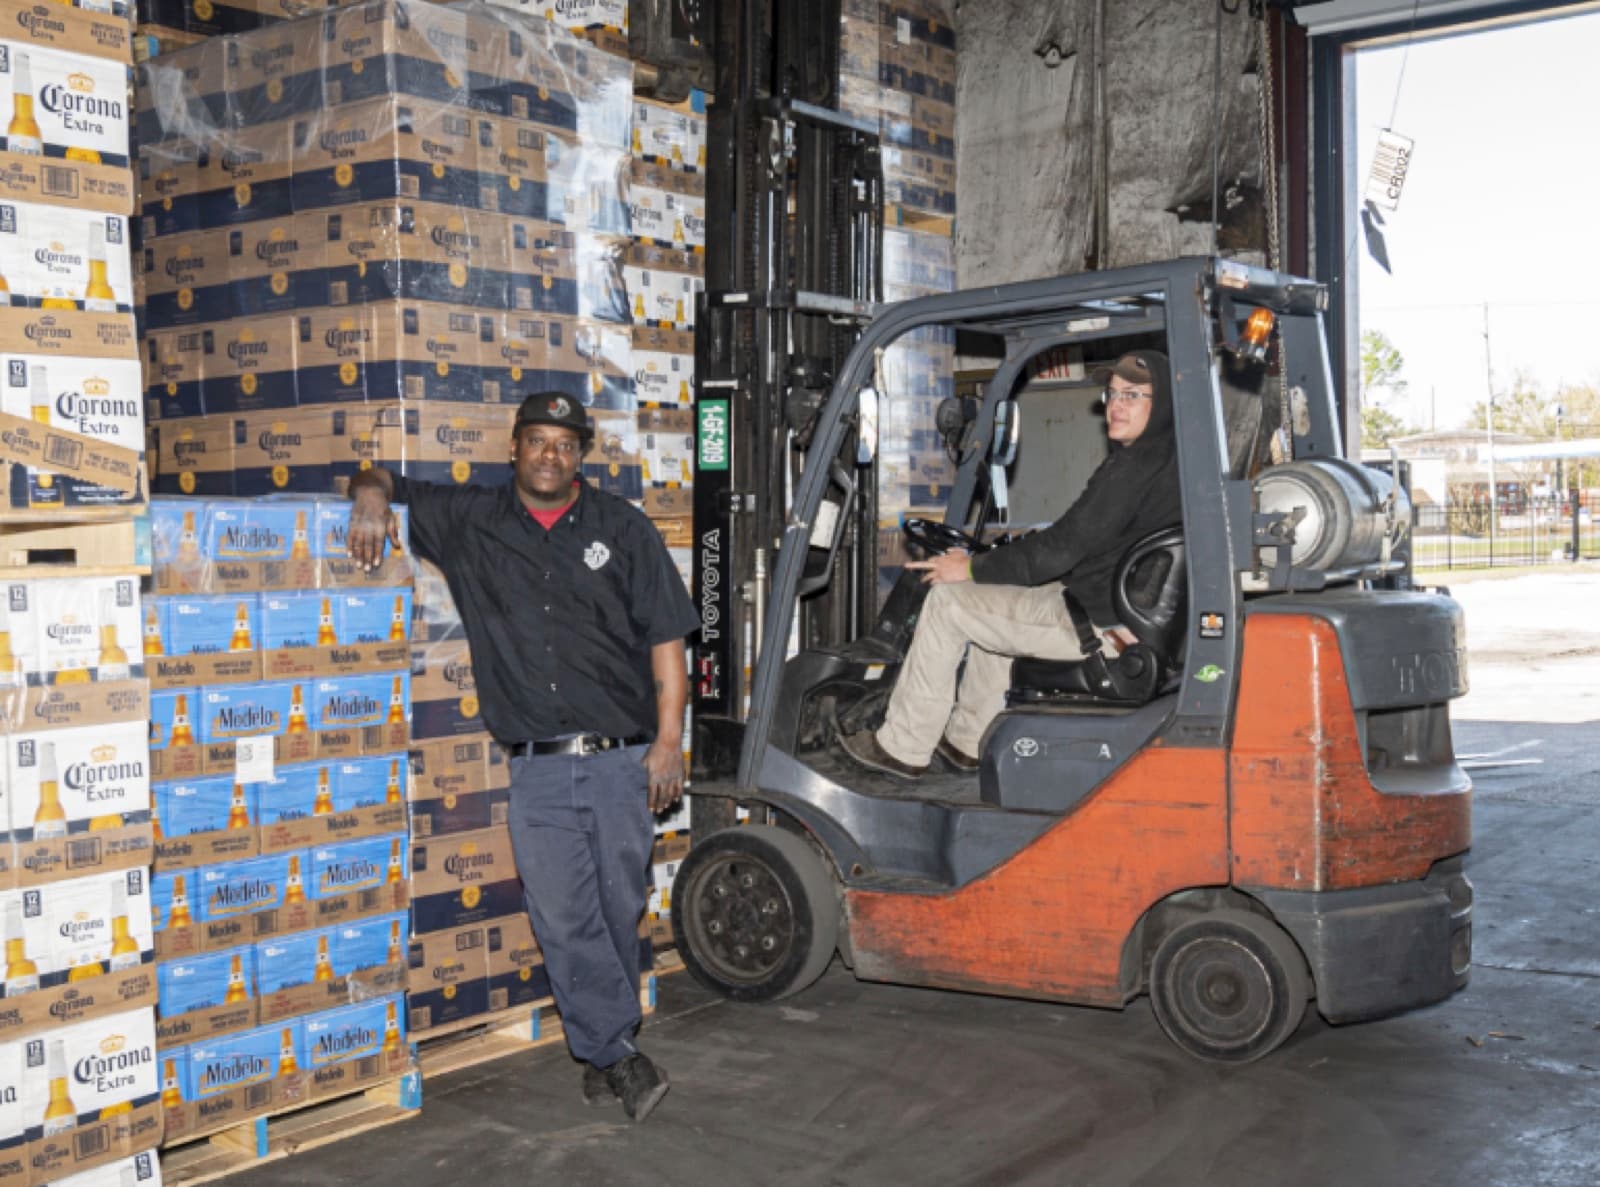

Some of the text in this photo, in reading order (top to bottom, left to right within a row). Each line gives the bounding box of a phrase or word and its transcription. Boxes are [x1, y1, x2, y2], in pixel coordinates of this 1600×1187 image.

[16, 10, 65, 33] Corona
[40, 83, 122, 120] Corona
[63, 112, 104, 135] Extra
[320, 127, 367, 149] Corona
[1386, 148, 1411, 200] CR002
[34, 248, 82, 265] Corona
[256, 238, 299, 260] Corona
[25, 323, 72, 338] Corona
[324, 327, 371, 349] Corona
[226, 340, 269, 360] Corona
[56, 391, 138, 420] Corona
[79, 416, 119, 434] Extra
[436, 424, 483, 445] Corona
[702, 405, 725, 464] 1-GF-209
[258, 430, 302, 451] Corona
[226, 525, 280, 548] Modelo
[702, 527, 721, 643] TOYOTA
[47, 623, 92, 638] Corona
[331, 650, 362, 663] Modelo
[157, 662, 195, 678] Modelo
[34, 701, 82, 717] Corona
[328, 694, 378, 716] Modelo
[219, 705, 274, 730] Modelo
[64, 760, 144, 791] Corona
[86, 784, 125, 802] Extra
[326, 860, 376, 885] Modelo
[444, 852, 494, 874] Corona
[216, 879, 270, 906] Modelo
[59, 918, 104, 938] Corona
[49, 996, 94, 1017] Corona
[319, 1026, 371, 1054] Modelo
[74, 1045, 152, 1085] Corona
[205, 1056, 262, 1086] Modelo
[313, 1067, 345, 1084] Modelo
[96, 1074, 136, 1093] Extra
[200, 1098, 233, 1116] Modelo
